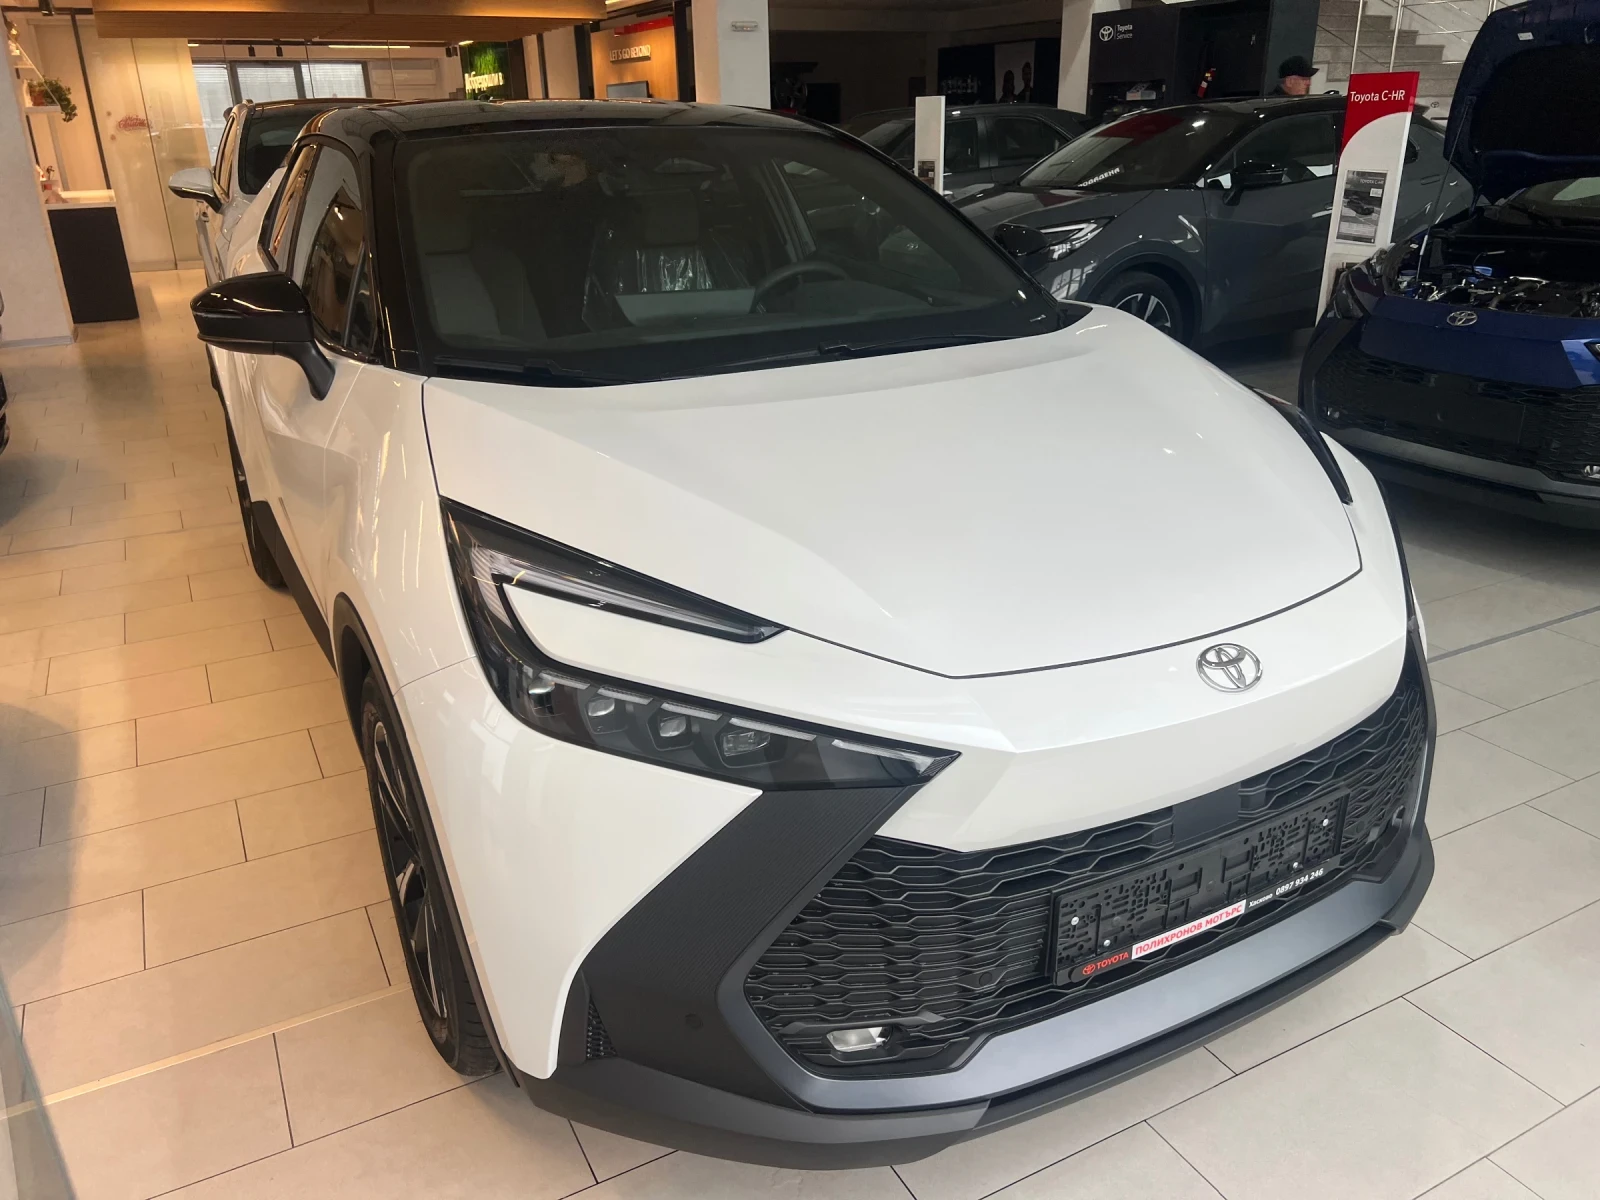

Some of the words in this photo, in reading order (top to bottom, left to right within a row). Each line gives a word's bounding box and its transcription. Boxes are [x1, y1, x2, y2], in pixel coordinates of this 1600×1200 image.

[1116, 24, 1133, 33] Toyota
[609, 49, 622, 61] LET'S
[622, 48, 631, 60] GO
[630, 44, 651, 58] BEYOND
[1350, 91, 1380, 104] Toyota
[1381, 89, 1406, 101] C-HR
[1096, 951, 1129, 970] TOYOTA
[1134, 922, 1203, 956] ПОЛИХРОНОВ
[1204, 904, 1243, 928] МОТЪРС
[1275, 880, 1295, 896] 0897
[1294, 874, 1309, 887] 934
[1309, 867, 1325, 880] 246
